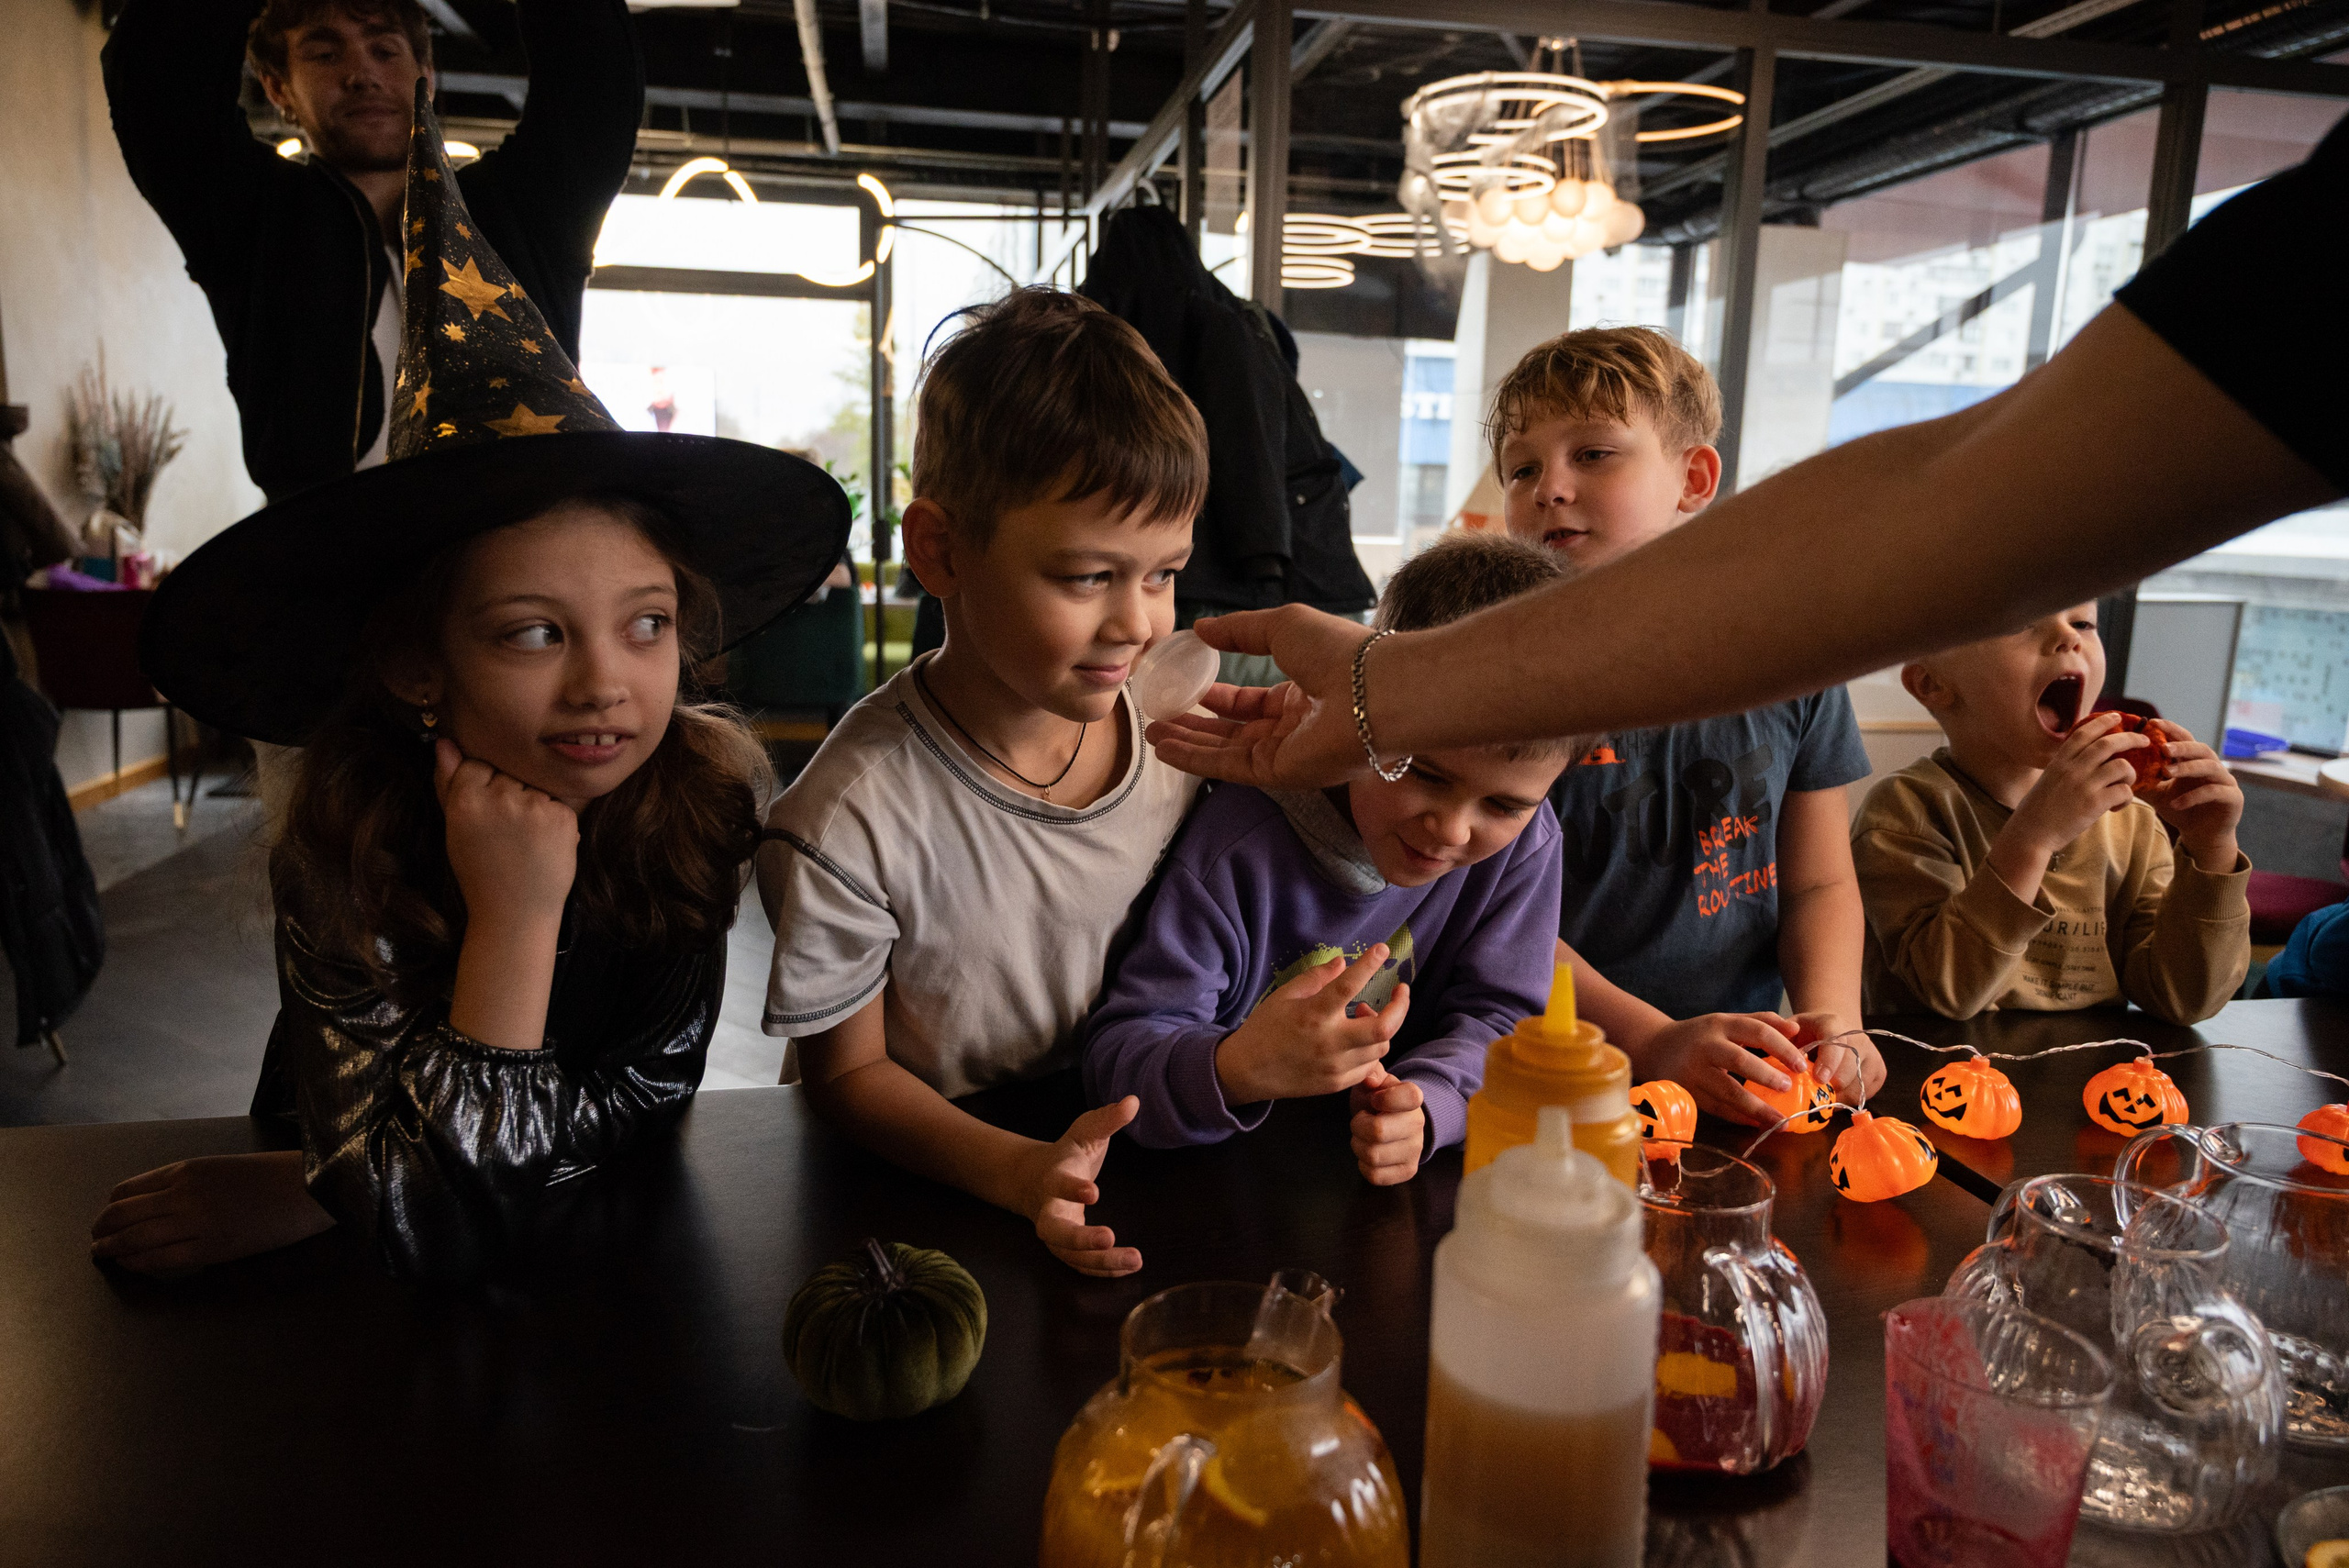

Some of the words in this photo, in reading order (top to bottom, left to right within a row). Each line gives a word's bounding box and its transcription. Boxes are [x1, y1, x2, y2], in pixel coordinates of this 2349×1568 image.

[1561, 744, 1773, 884] UTURE
[1698, 815, 1758, 856] BREAK
[1694, 852, 1729, 888] THE
[1698, 862, 1776, 917] ROUTINE
